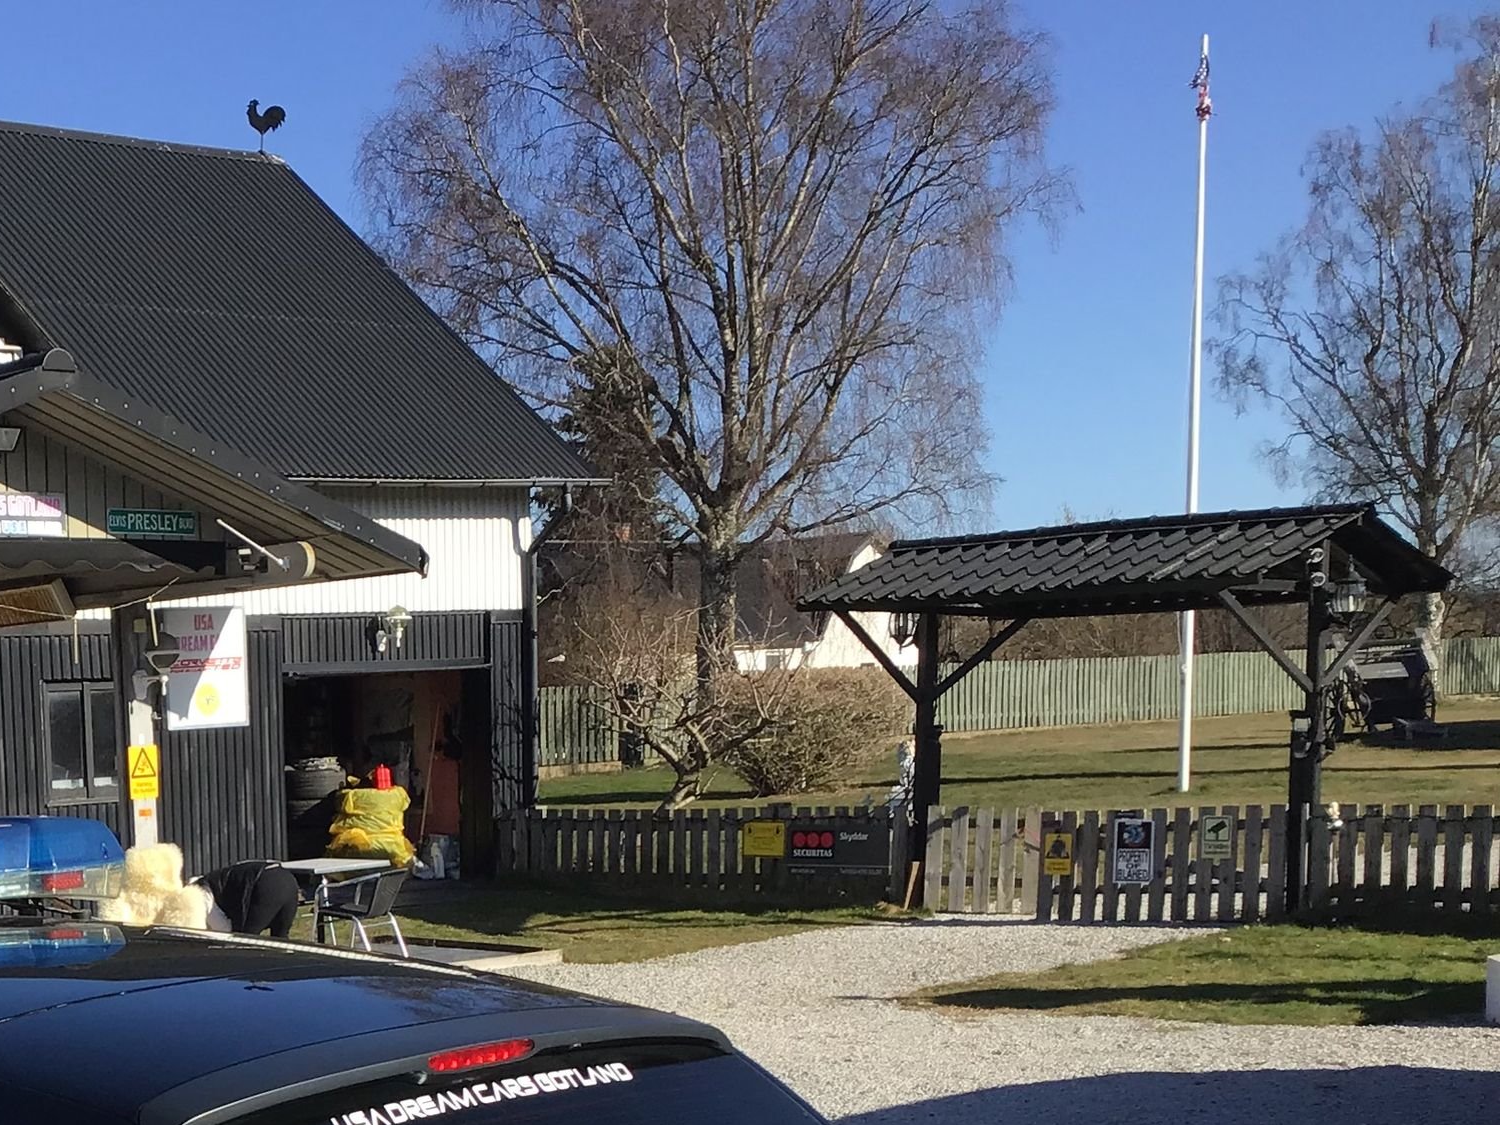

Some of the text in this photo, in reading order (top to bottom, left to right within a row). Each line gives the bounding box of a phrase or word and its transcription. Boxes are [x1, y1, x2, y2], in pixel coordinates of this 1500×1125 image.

[109, 515, 127, 527] ELVIS
[127, 513, 178, 531] PRESLEY
[194, 614, 214, 630] USA
[839, 832, 869, 842] Skyddar
[793, 849, 833, 857] SECURITAS
[384, 1091, 477, 1125] DREAM
[471, 1076, 540, 1104] CARS
[535, 1062, 633, 1092] GOTLAND
